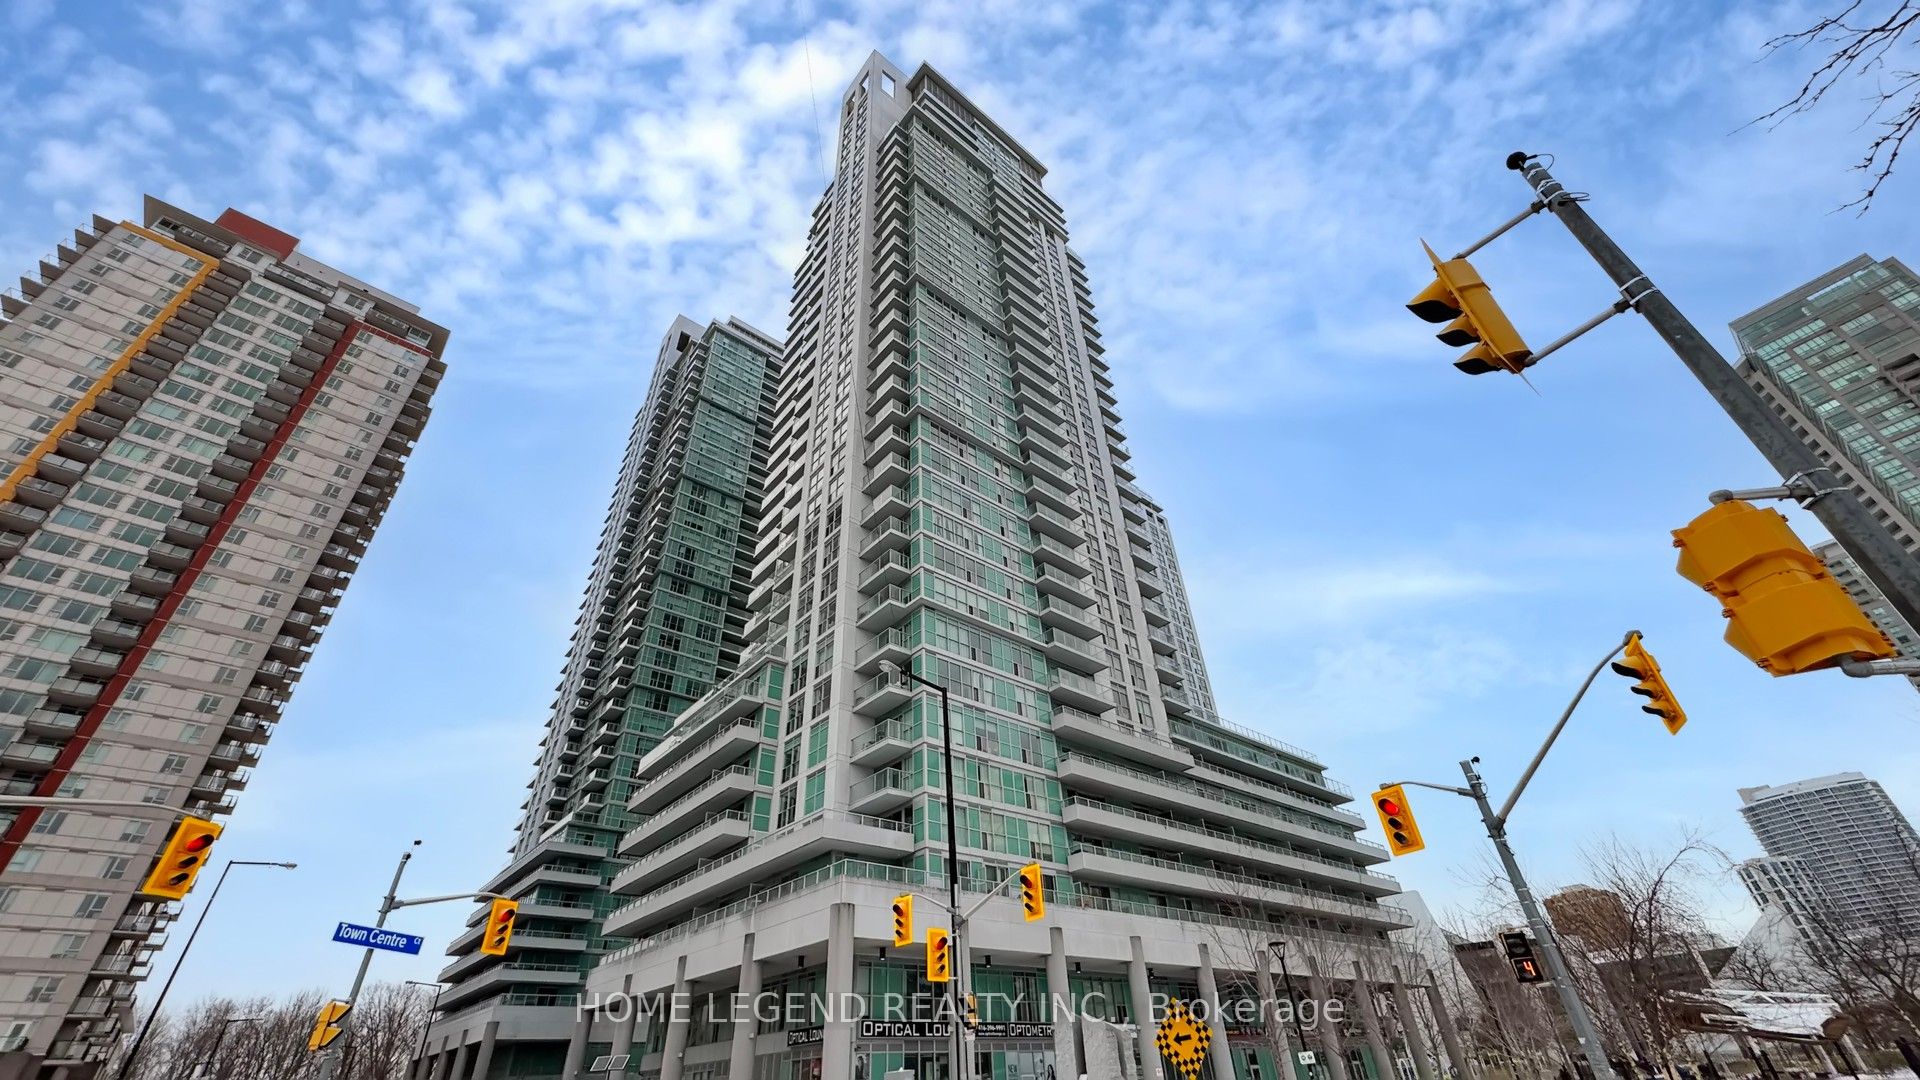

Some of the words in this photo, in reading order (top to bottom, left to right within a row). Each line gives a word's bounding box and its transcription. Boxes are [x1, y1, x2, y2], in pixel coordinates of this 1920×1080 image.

[339, 923, 368, 942] Town
[369, 930, 407, 948] Centre
[1523, 961, 1536, 976] 4
[863, 1021, 920, 1036] OPTICAL
